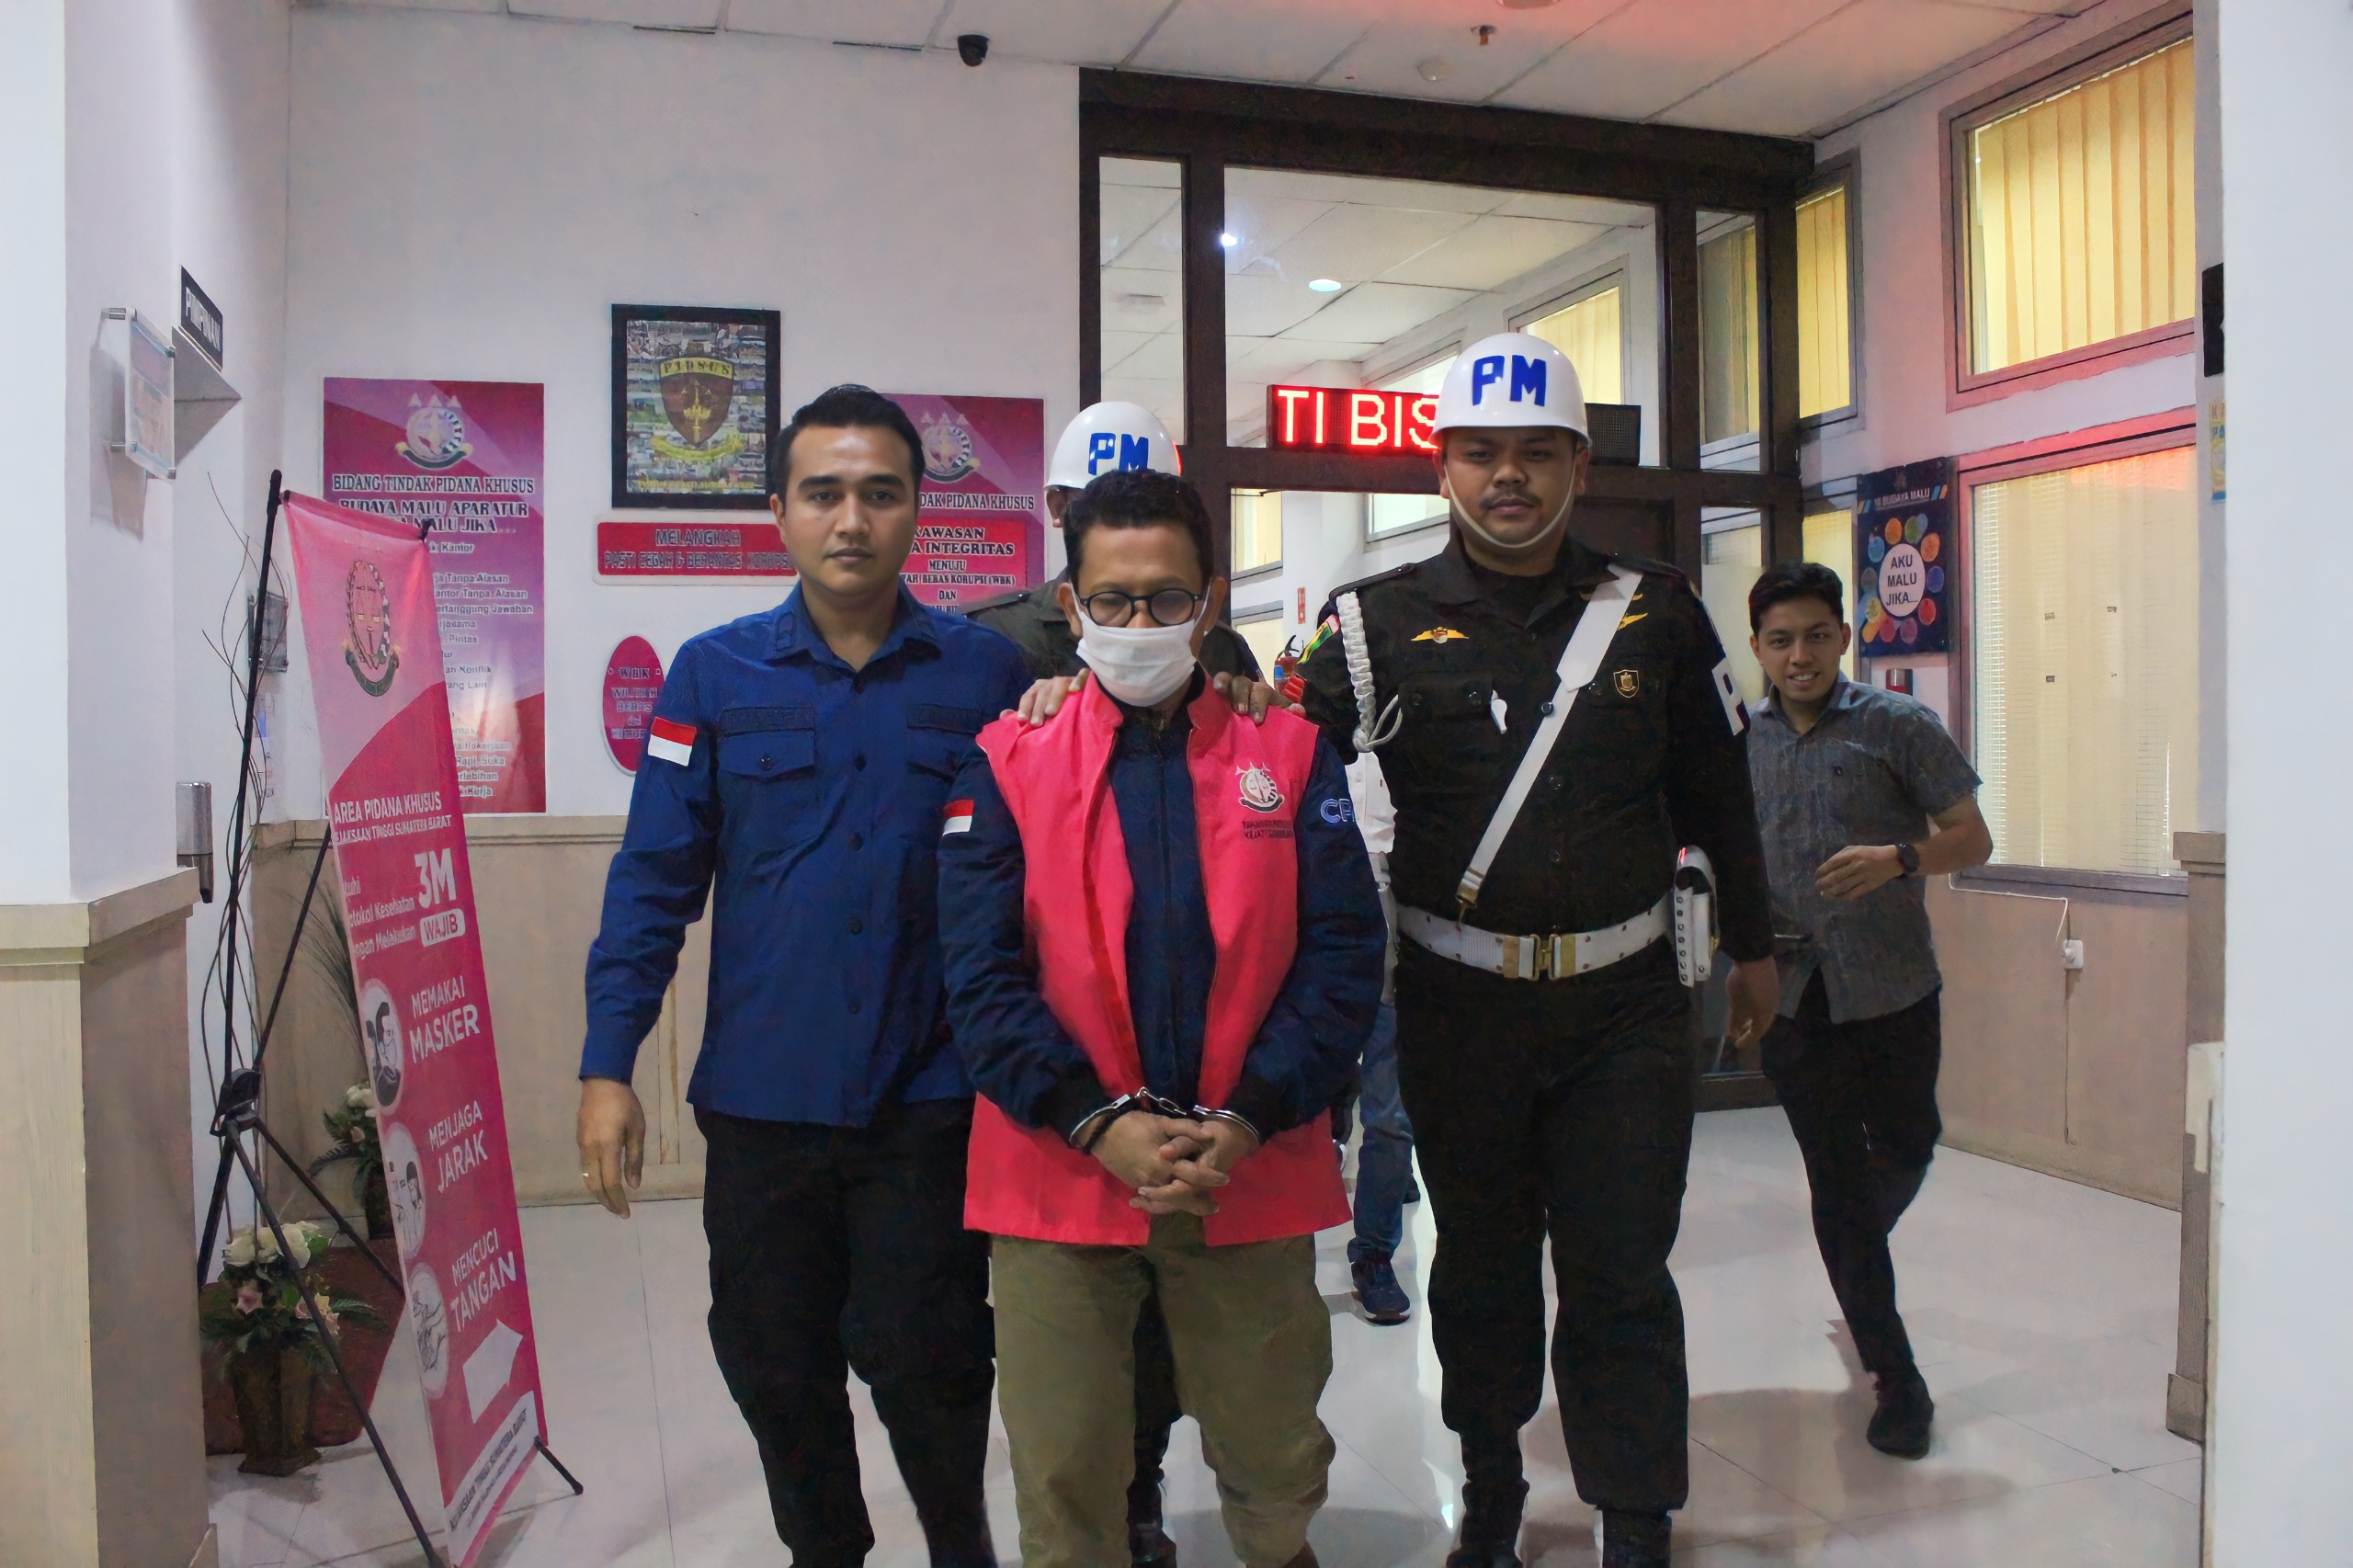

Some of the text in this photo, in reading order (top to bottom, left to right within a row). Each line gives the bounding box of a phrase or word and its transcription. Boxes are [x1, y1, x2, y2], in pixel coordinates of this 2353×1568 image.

[664, 359, 731, 375] PIDSUS
[1472, 354, 1547, 407] PM
[1278, 390, 1325, 445] TI
[1087, 432, 1149, 475] PM
[333, 475, 534, 494] BIDANG TINDAK PIDANA KHUSUS
[402, 500, 447, 517] MALU
[451, 501, 529, 517] APARATUR
[946, 494, 986, 509] PIDANA
[990, 494, 1035, 510] KHUSUS
[925, 541, 1015, 555] INTEGRITAS
[1890, 554, 1913, 569] AKU
[928, 560, 967, 572] MENUJU
[1887, 572, 1917, 587] MALU
[938, 590, 957, 600] DAN
[334, 791, 442, 825] AREA PIDANA KHUSUS
[414, 847, 457, 909] 3M
[424, 913, 459, 941] WAJIB
[411, 974, 466, 1018] MEMAKAI
[409, 1004, 481, 1063] MASKER
[428, 1100, 483, 1152] MENJAGA
[438, 1130, 489, 1194] JARAK
[451, 1227, 500, 1287] MENCUCI
[449, 1250, 517, 1333] TANGAN
